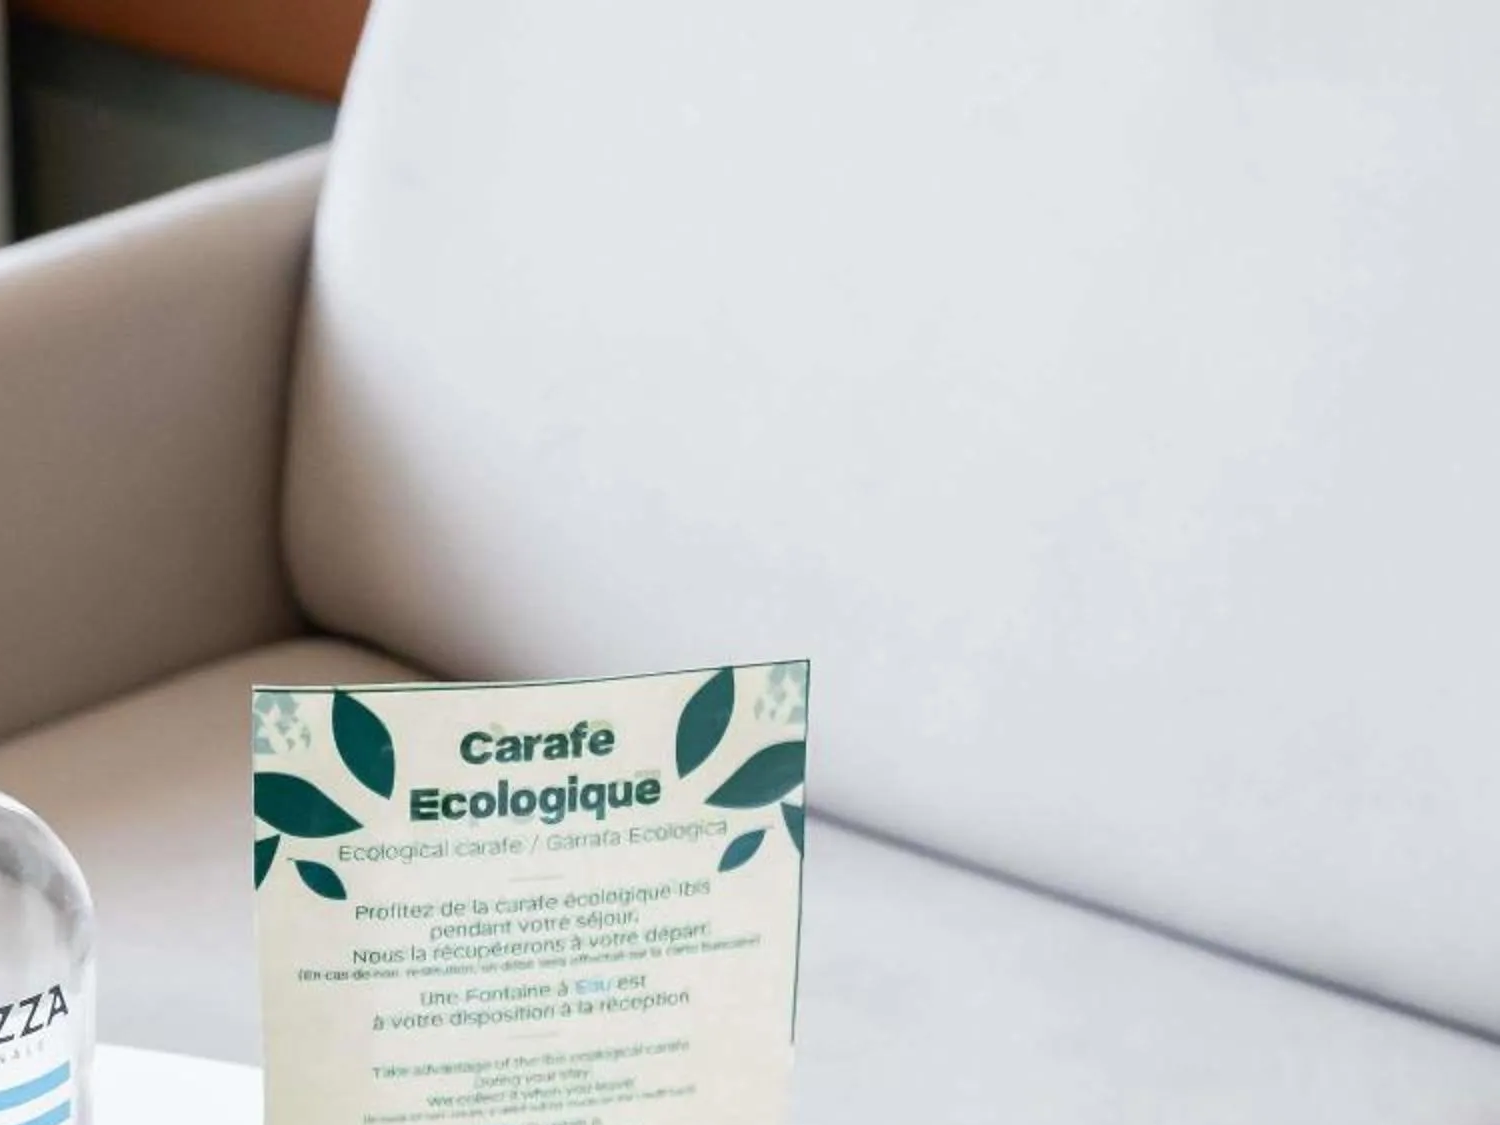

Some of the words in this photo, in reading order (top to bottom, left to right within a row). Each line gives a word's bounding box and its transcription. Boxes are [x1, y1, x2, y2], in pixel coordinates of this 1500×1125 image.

[459, 720, 616, 766] Carafe
[409, 776, 661, 824] Ecologique
[338, 832, 449, 863] Ecological
[455, 835, 522, 858] carafe
[354, 900, 432, 922] Profitez
[441, 898, 465, 915] de
[472, 896, 488, 912] la
[430, 918, 511, 940] pendant
[518, 916, 570, 933] votre
[353, 947, 403, 965] Nous
[411, 945, 426, 960] la
[589, 929, 638, 947] votre
[617, 974, 646, 990] est
[390, 1012, 441, 1030] votre
[449, 1001, 553, 1028] disposition
[578, 998, 593, 1014] la
